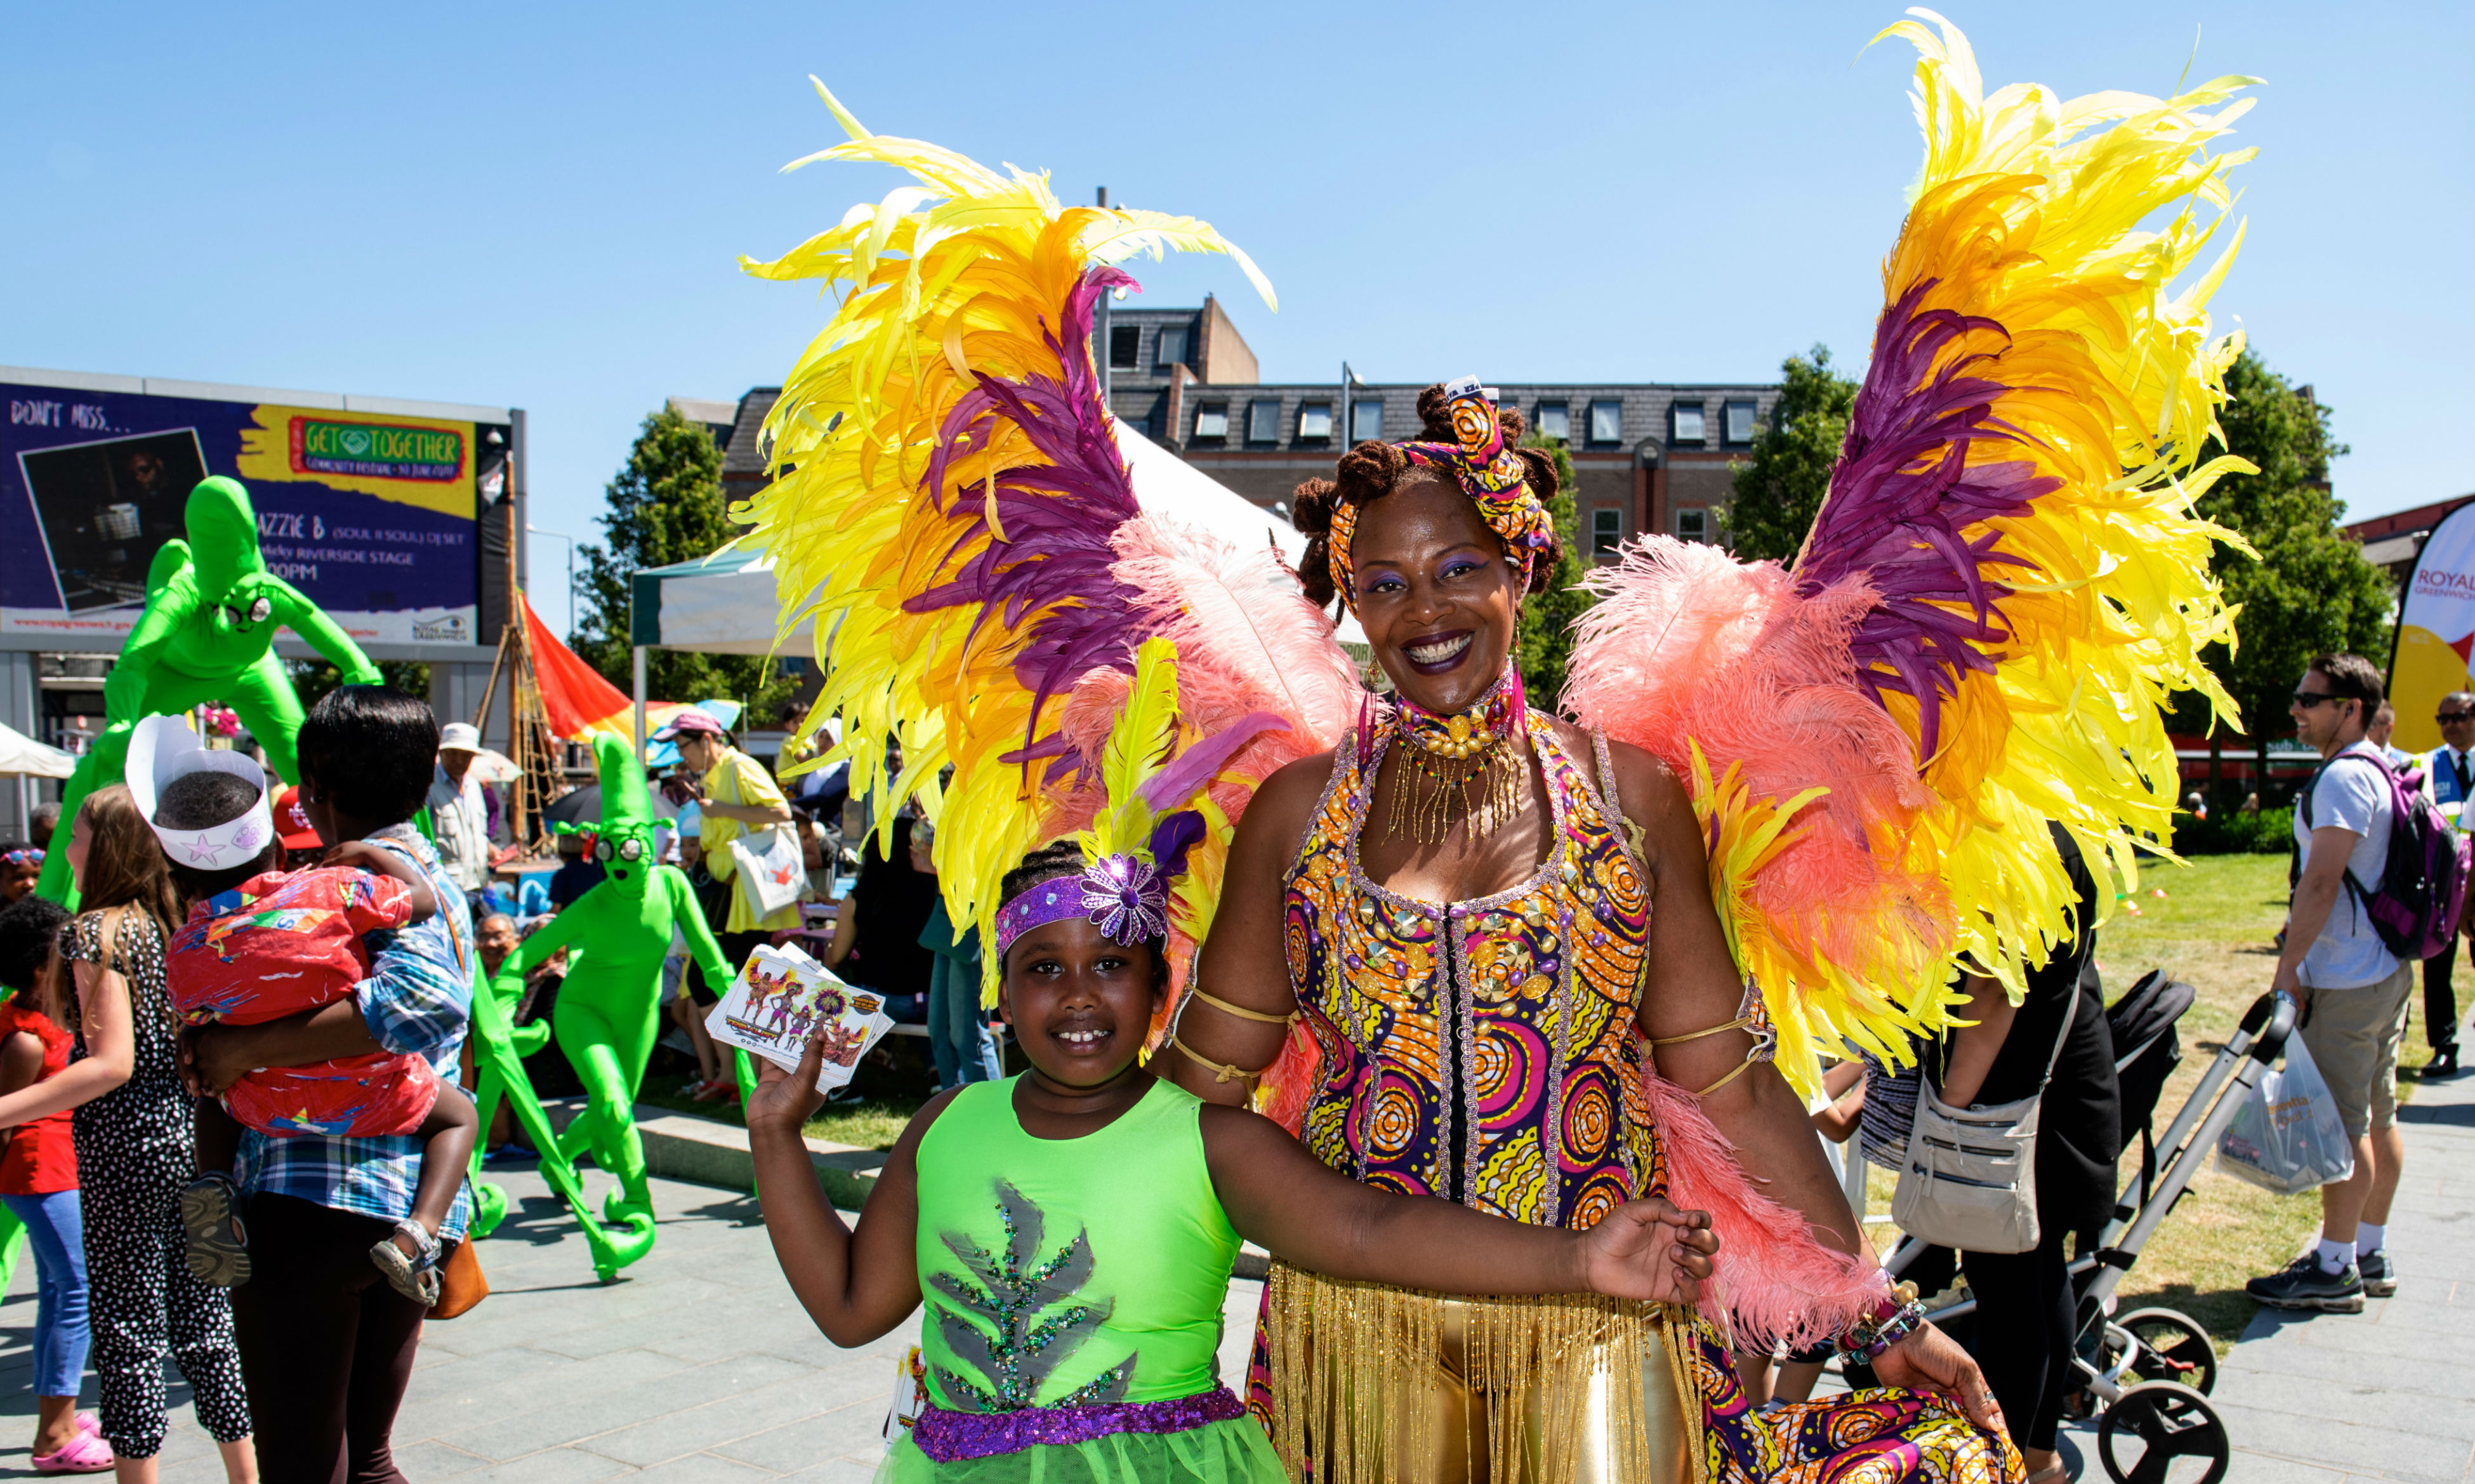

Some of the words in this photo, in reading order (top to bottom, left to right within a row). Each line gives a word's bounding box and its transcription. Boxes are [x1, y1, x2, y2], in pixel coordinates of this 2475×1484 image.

[1463, 383, 1481, 393] PER
[11, 400, 63, 428] DON'T
[306, 424, 339, 454] GET
[369, 430, 456, 463] TOGETHER
[254, 512, 305, 539] AZZIE
[313, 515, 326, 540] B
[332, 527, 371, 540] (SOUL
[383, 529, 424, 544] SOUL)
[426, 532, 441, 546] DJ
[443, 533, 465, 546] SET
[296, 547, 366, 564] RIVERSIDE
[369, 551, 414, 566] STAGE
[267, 562, 317, 581] 00PM
[2418, 569, 2475, 591] ROYAL
